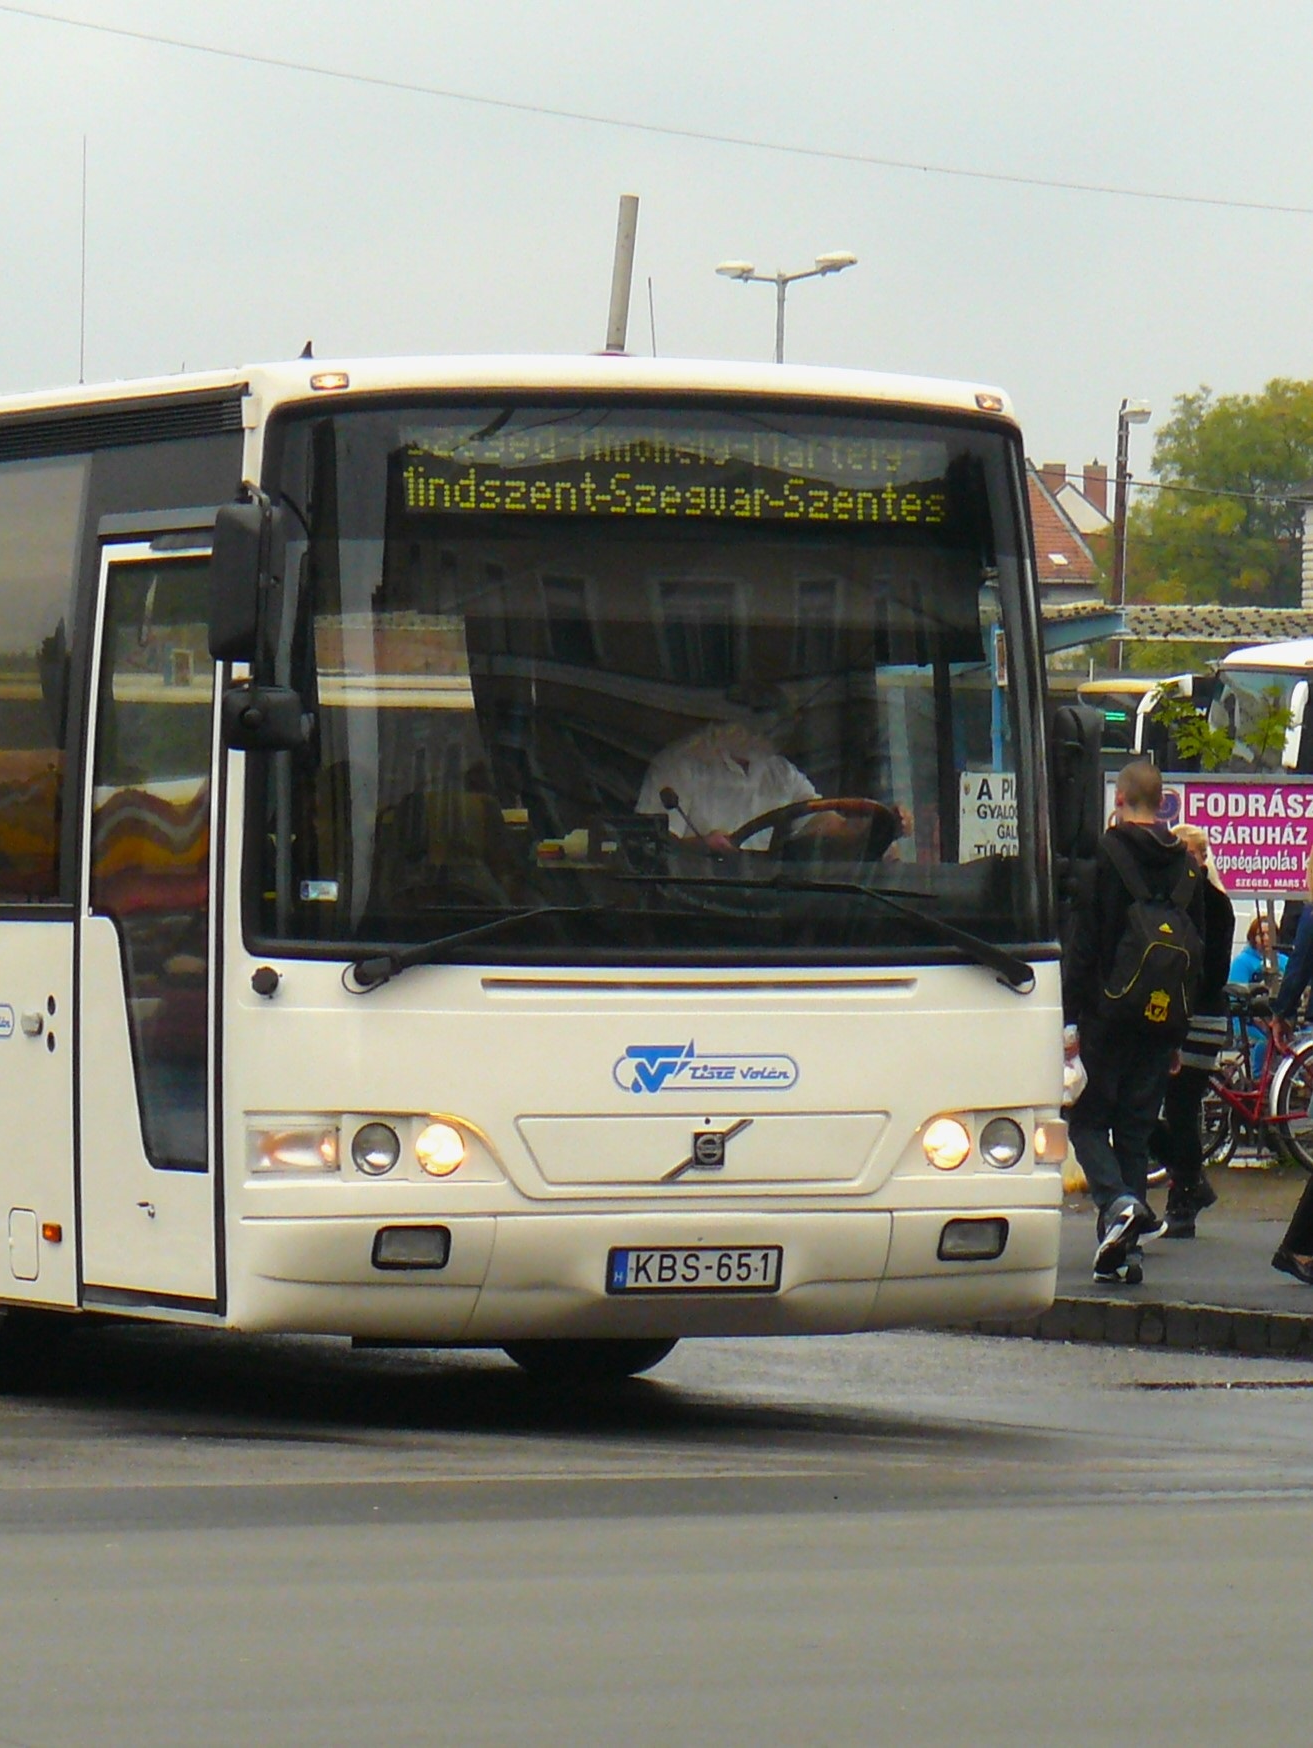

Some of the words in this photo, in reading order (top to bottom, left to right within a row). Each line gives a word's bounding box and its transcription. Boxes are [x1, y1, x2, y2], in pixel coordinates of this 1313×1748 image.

[976, 777, 993, 801] A
[1001, 777, 1017, 801] PI
[1235, 878, 1272, 888] SZEGED,
[1274, 878, 1300, 888] MARS
[614, 1271, 623, 1282] H
[634, 1252, 770, 1283] KBS-651
